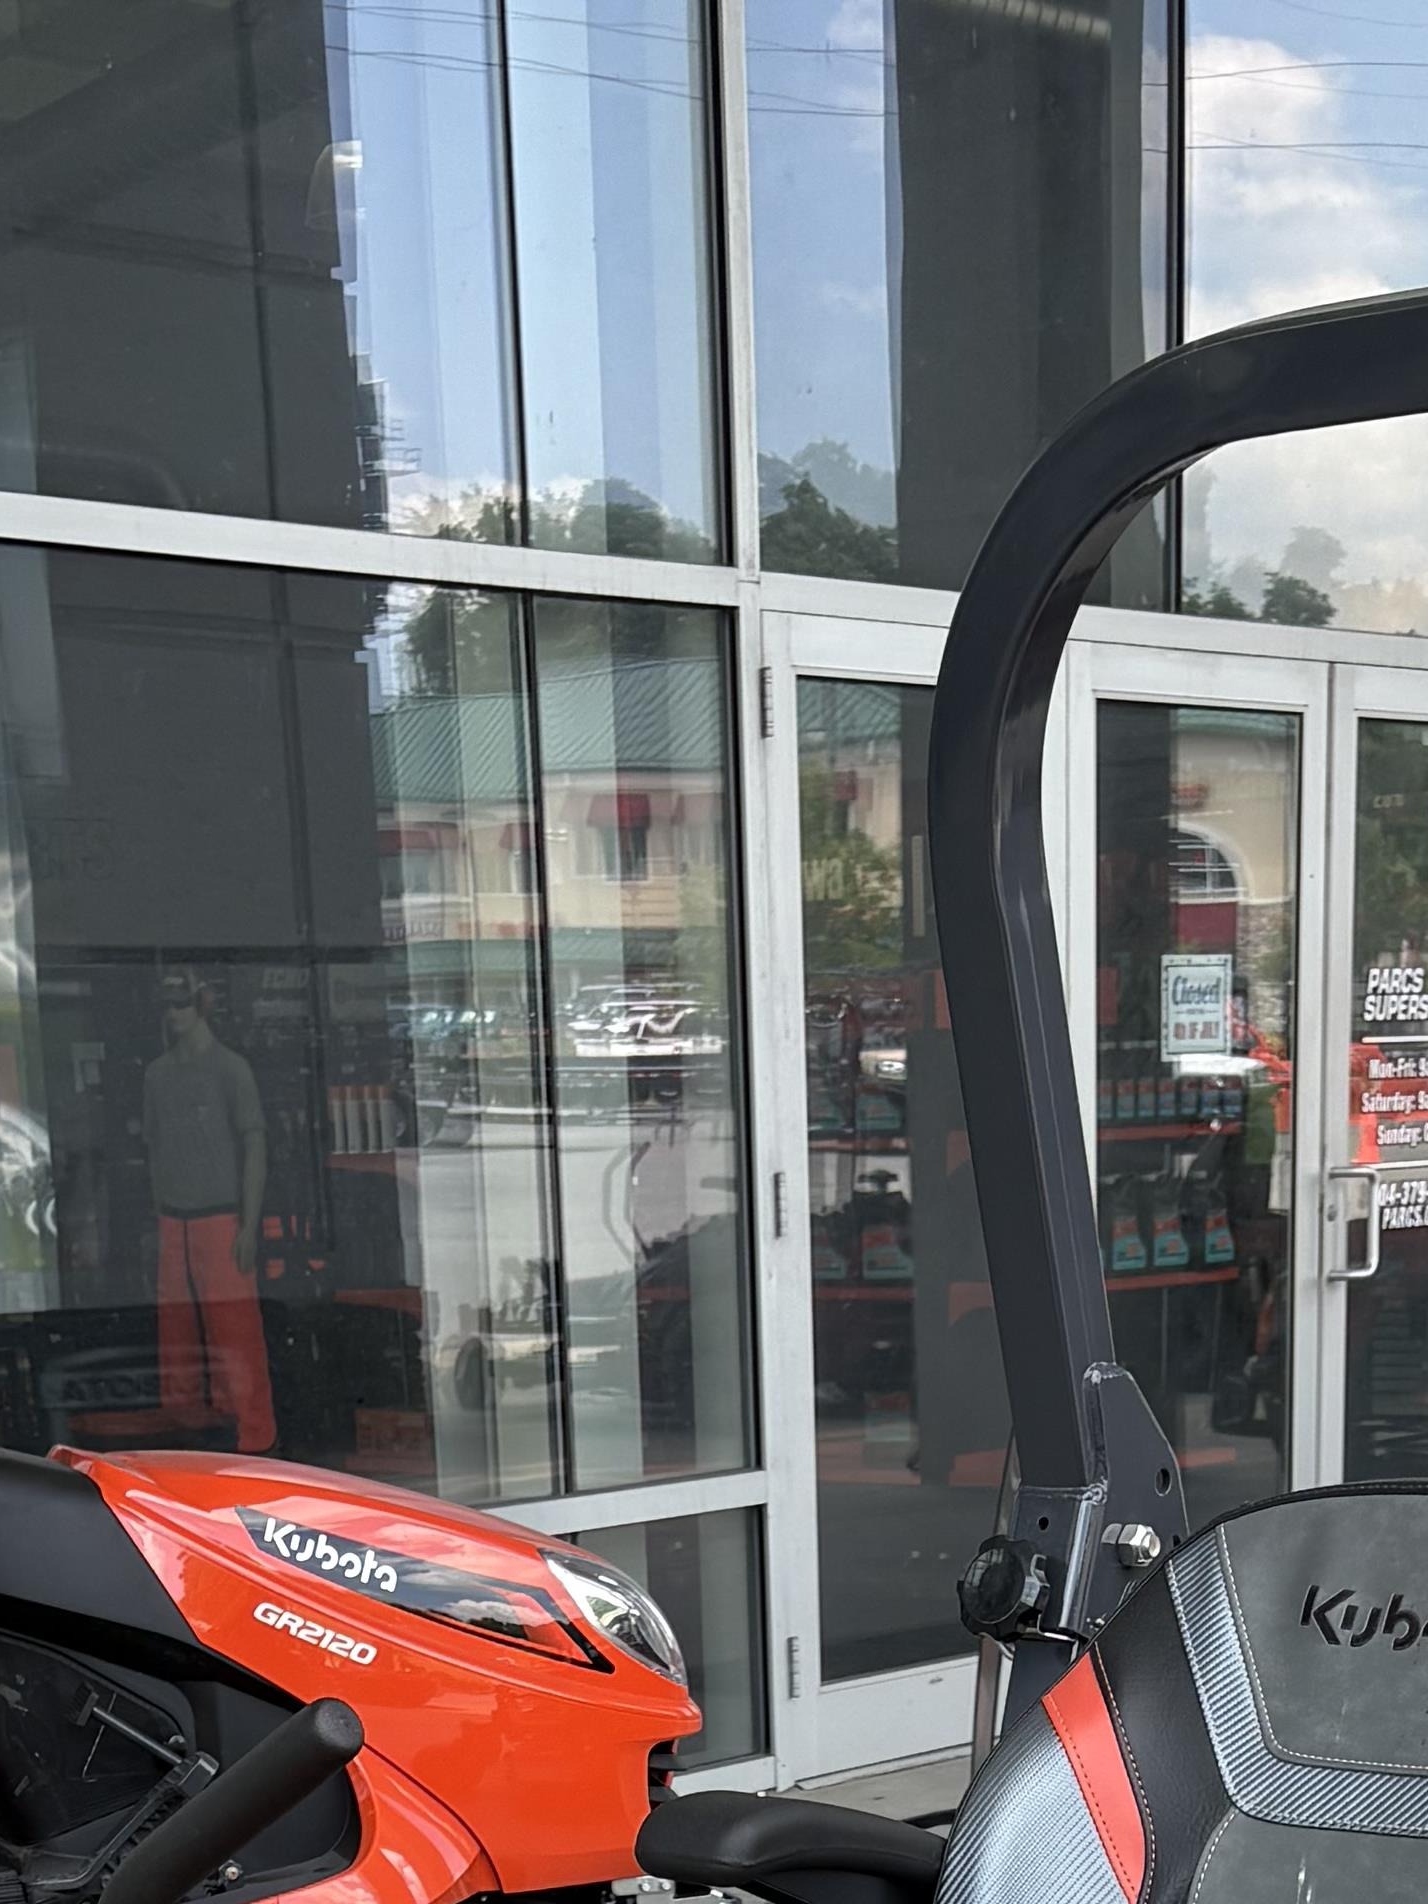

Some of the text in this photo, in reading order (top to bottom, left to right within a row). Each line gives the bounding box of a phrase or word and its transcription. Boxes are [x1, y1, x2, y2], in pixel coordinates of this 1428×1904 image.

[1367, 968, 1424, 994] PARCS
[1362, 1091, 1416, 1114] Saturday:
[1377, 1125, 1422, 1148] Sunday:
[263, 1517, 398, 1593] Kubota
[253, 1602, 377, 1665] GR2120
